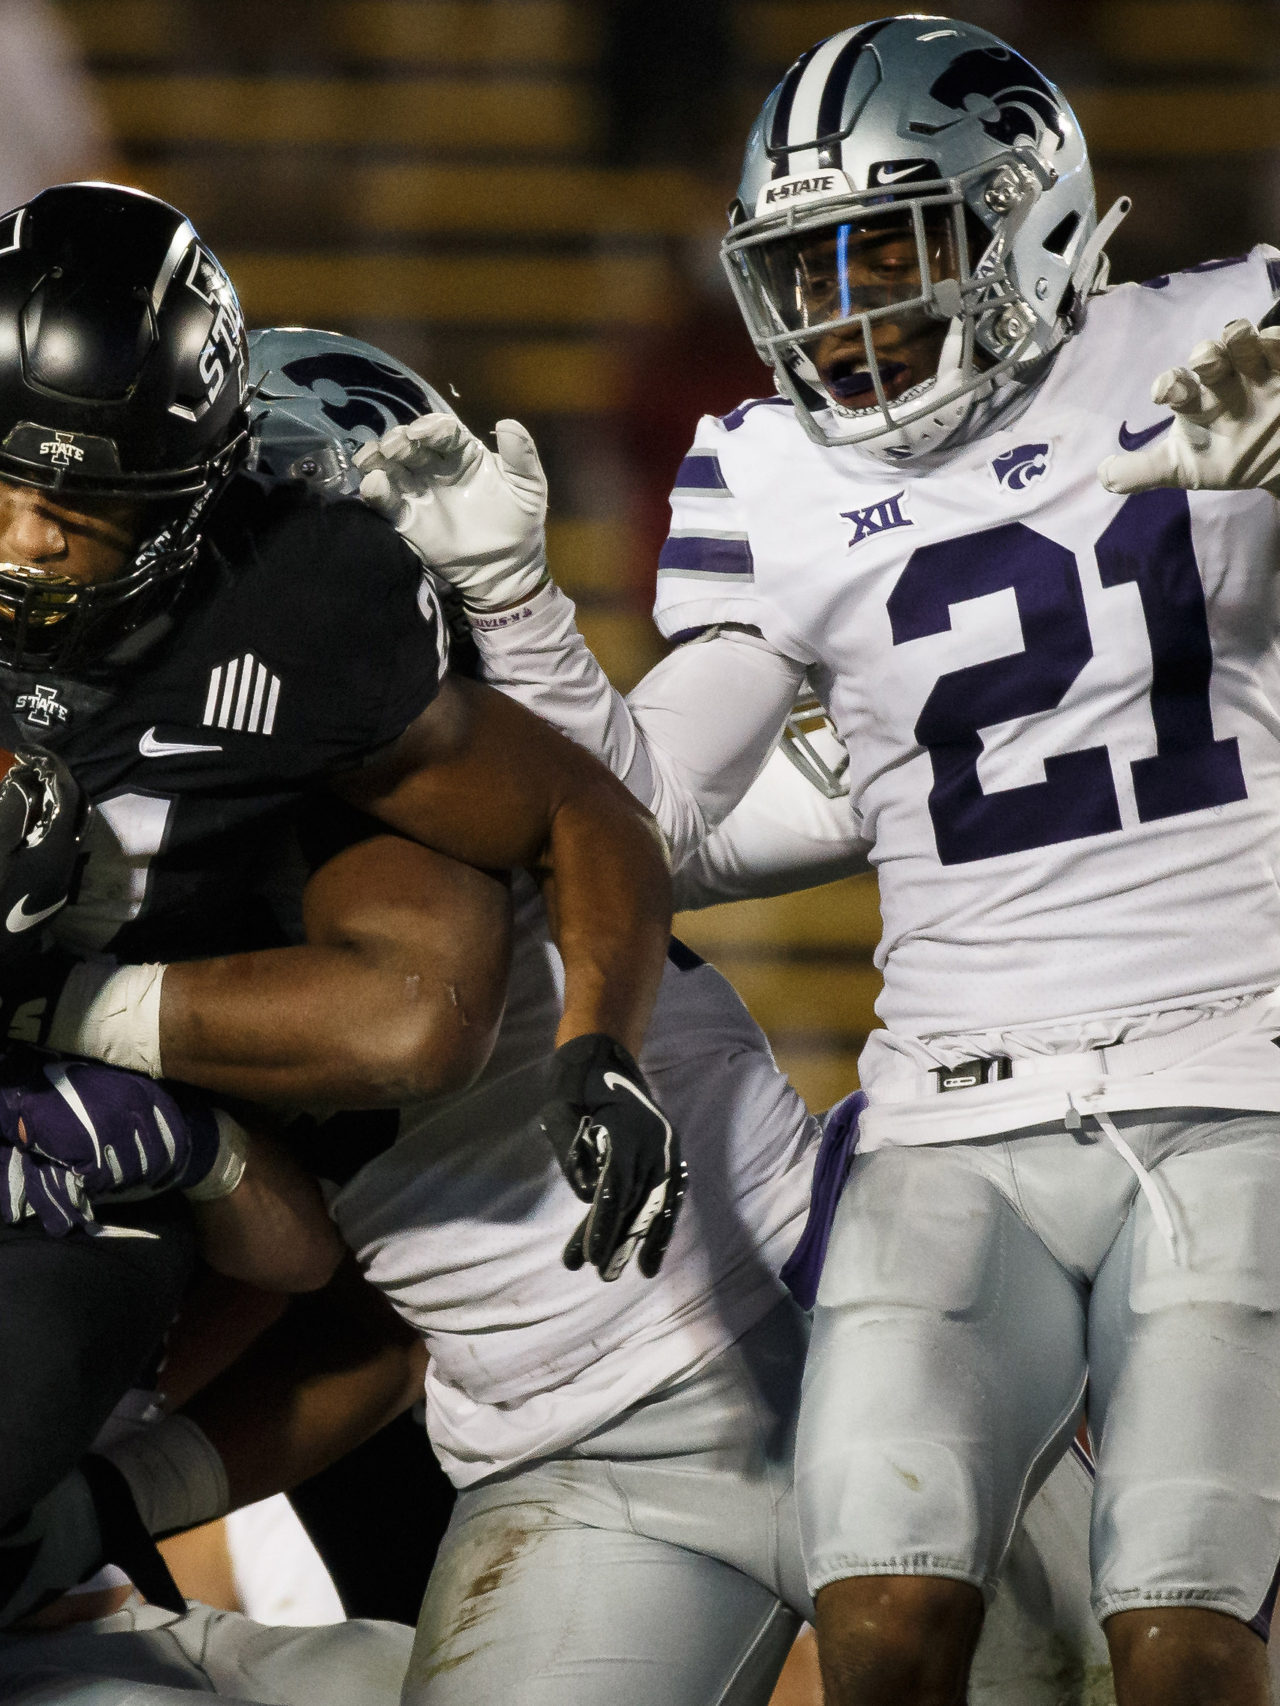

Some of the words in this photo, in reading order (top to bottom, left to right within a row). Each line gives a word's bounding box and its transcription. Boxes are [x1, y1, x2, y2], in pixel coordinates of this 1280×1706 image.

[766, 176, 835, 205] K-STATE
[39, 441, 84, 462] STATE
[839, 490, 914, 549] XII
[886, 487, 1249, 867] 21
[15, 695, 69, 722] STATE
